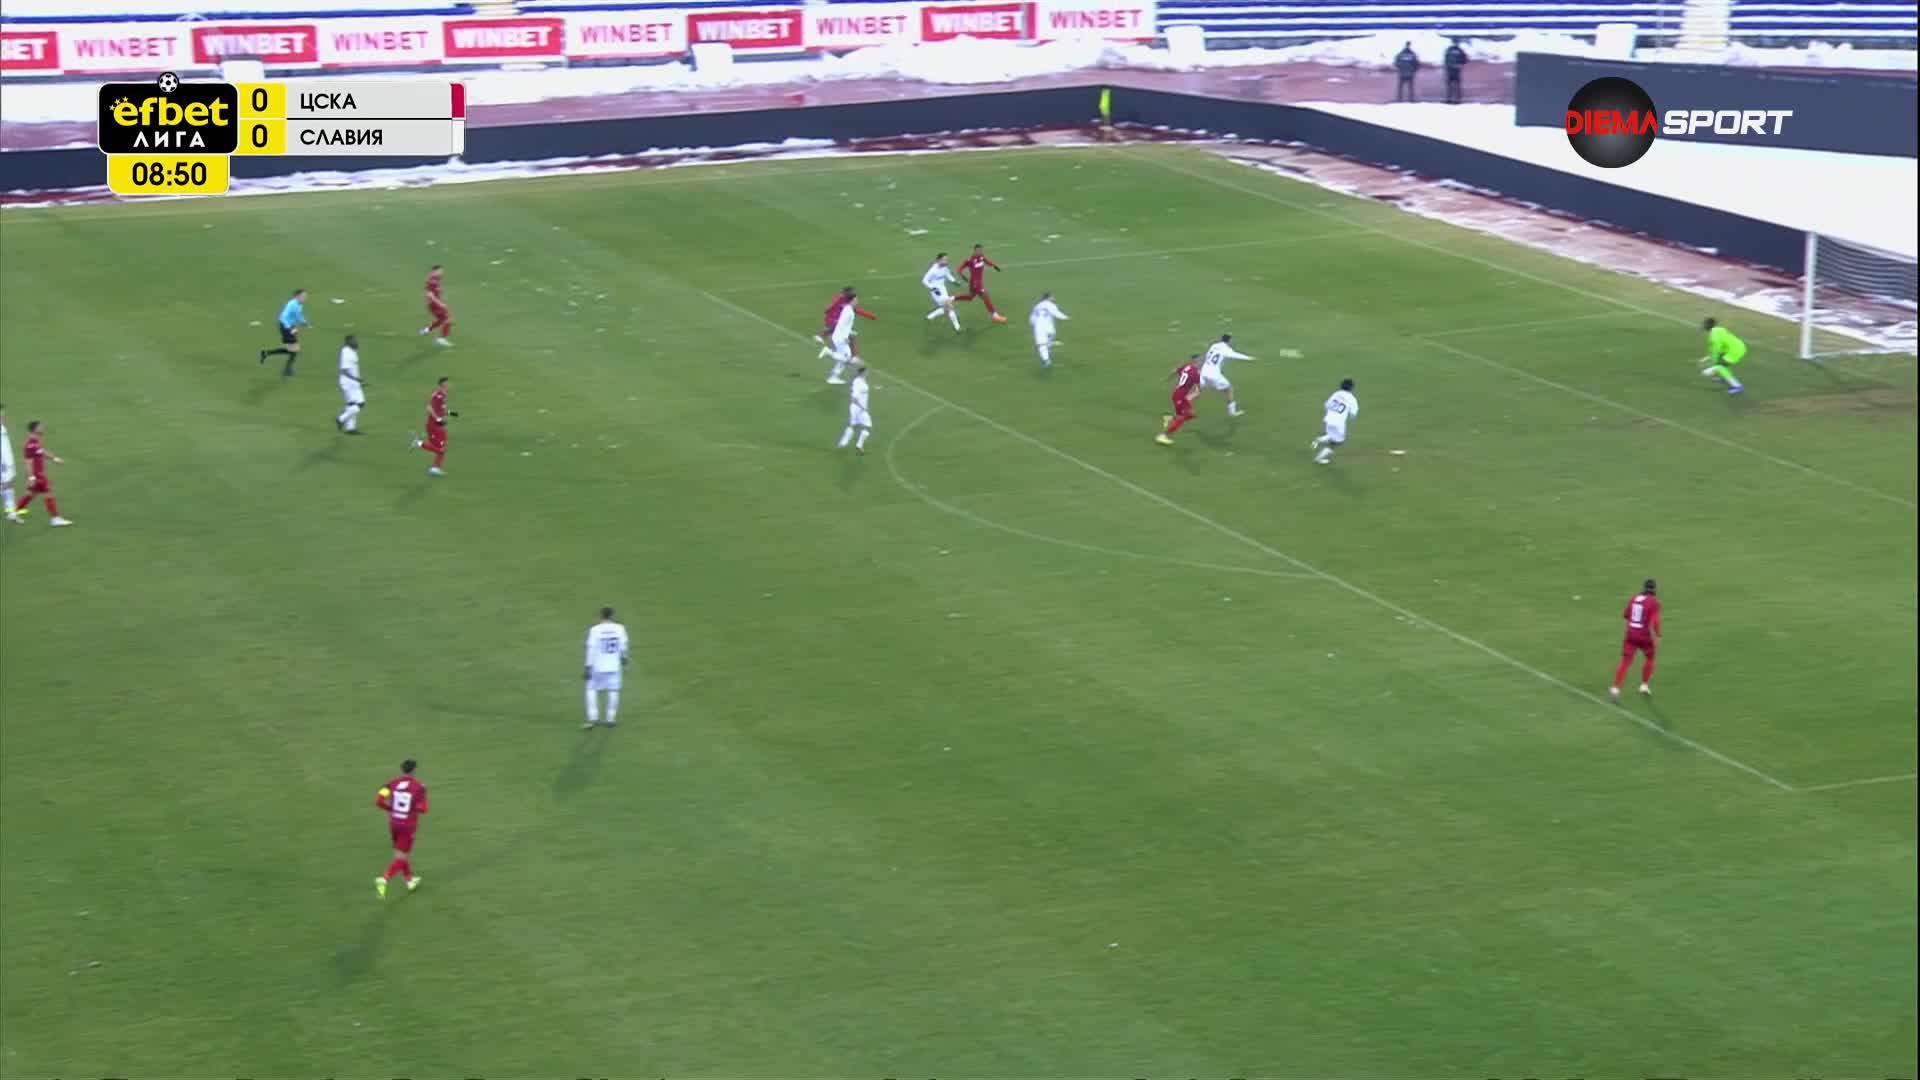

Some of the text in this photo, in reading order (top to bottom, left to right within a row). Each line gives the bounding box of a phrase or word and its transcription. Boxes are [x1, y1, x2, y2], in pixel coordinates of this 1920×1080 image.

[696, 18, 793, 41] WINBET
[815, 15, 907, 35] WINBET
[930, 10, 1023, 33] WINBET
[1049, 9, 1142, 29] WINBET
[332, 30, 428, 51] WINBET
[452, 26, 552, 48] WINBET
[580, 22, 673, 43] WINBET
[74, 36, 177, 57] WINBET
[201, 32, 308, 56] WINBET
